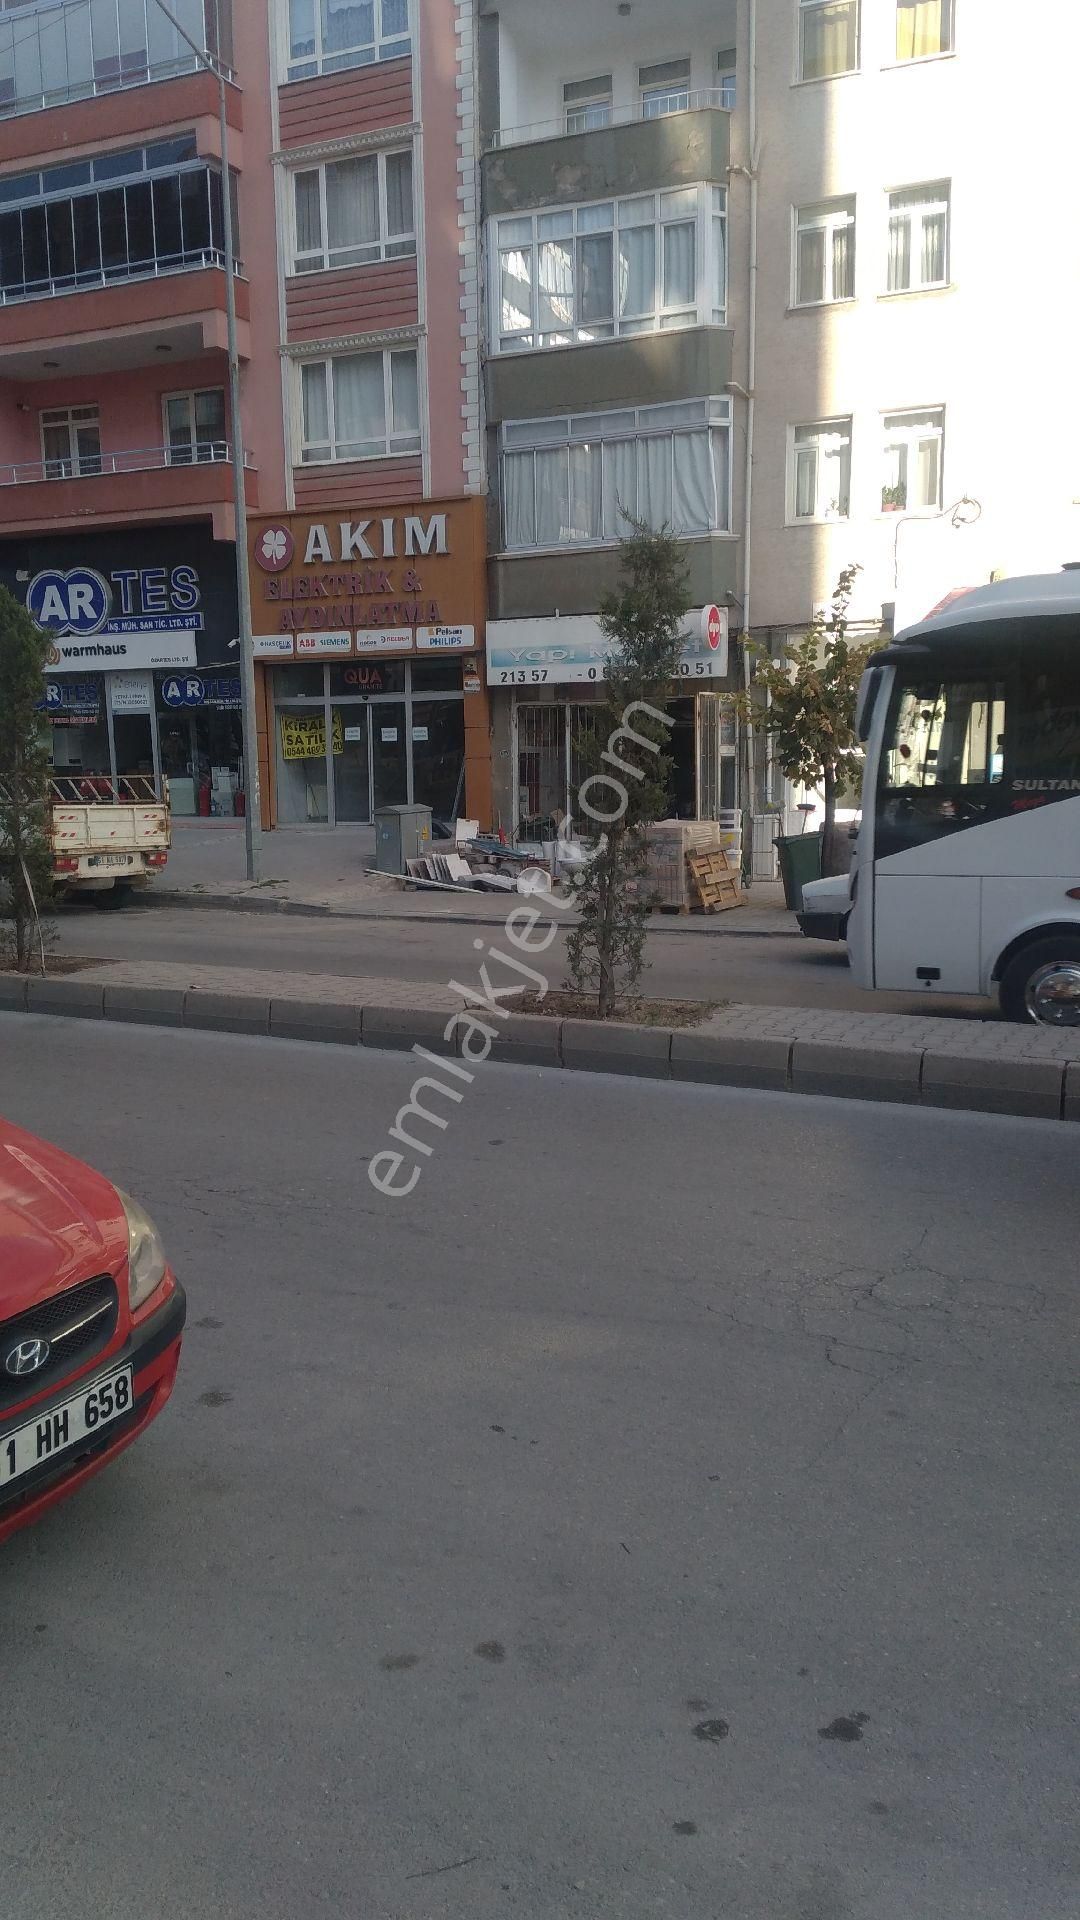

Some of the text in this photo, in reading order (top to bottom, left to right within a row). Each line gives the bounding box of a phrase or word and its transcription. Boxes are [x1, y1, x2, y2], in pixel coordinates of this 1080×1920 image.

[303, 514, 448, 563] AKIM
[265, 566, 422, 600] ELEKTRİK &
[280, 600, 442, 630] AYDINLATMA
[299, 638, 316, 648] ABB
[319, 638, 350, 646] SIEMENS
[429, 636, 462, 646] PHILIPS
[61, 643, 127, 658] warmhaus
[344, 668, 383, 684] QUA
[500, 671, 526, 682] 213
[531, 669, 548, 681] 57
[36, 1408, 69, 1460] HH
[84, 1375, 129, 1429] 658
